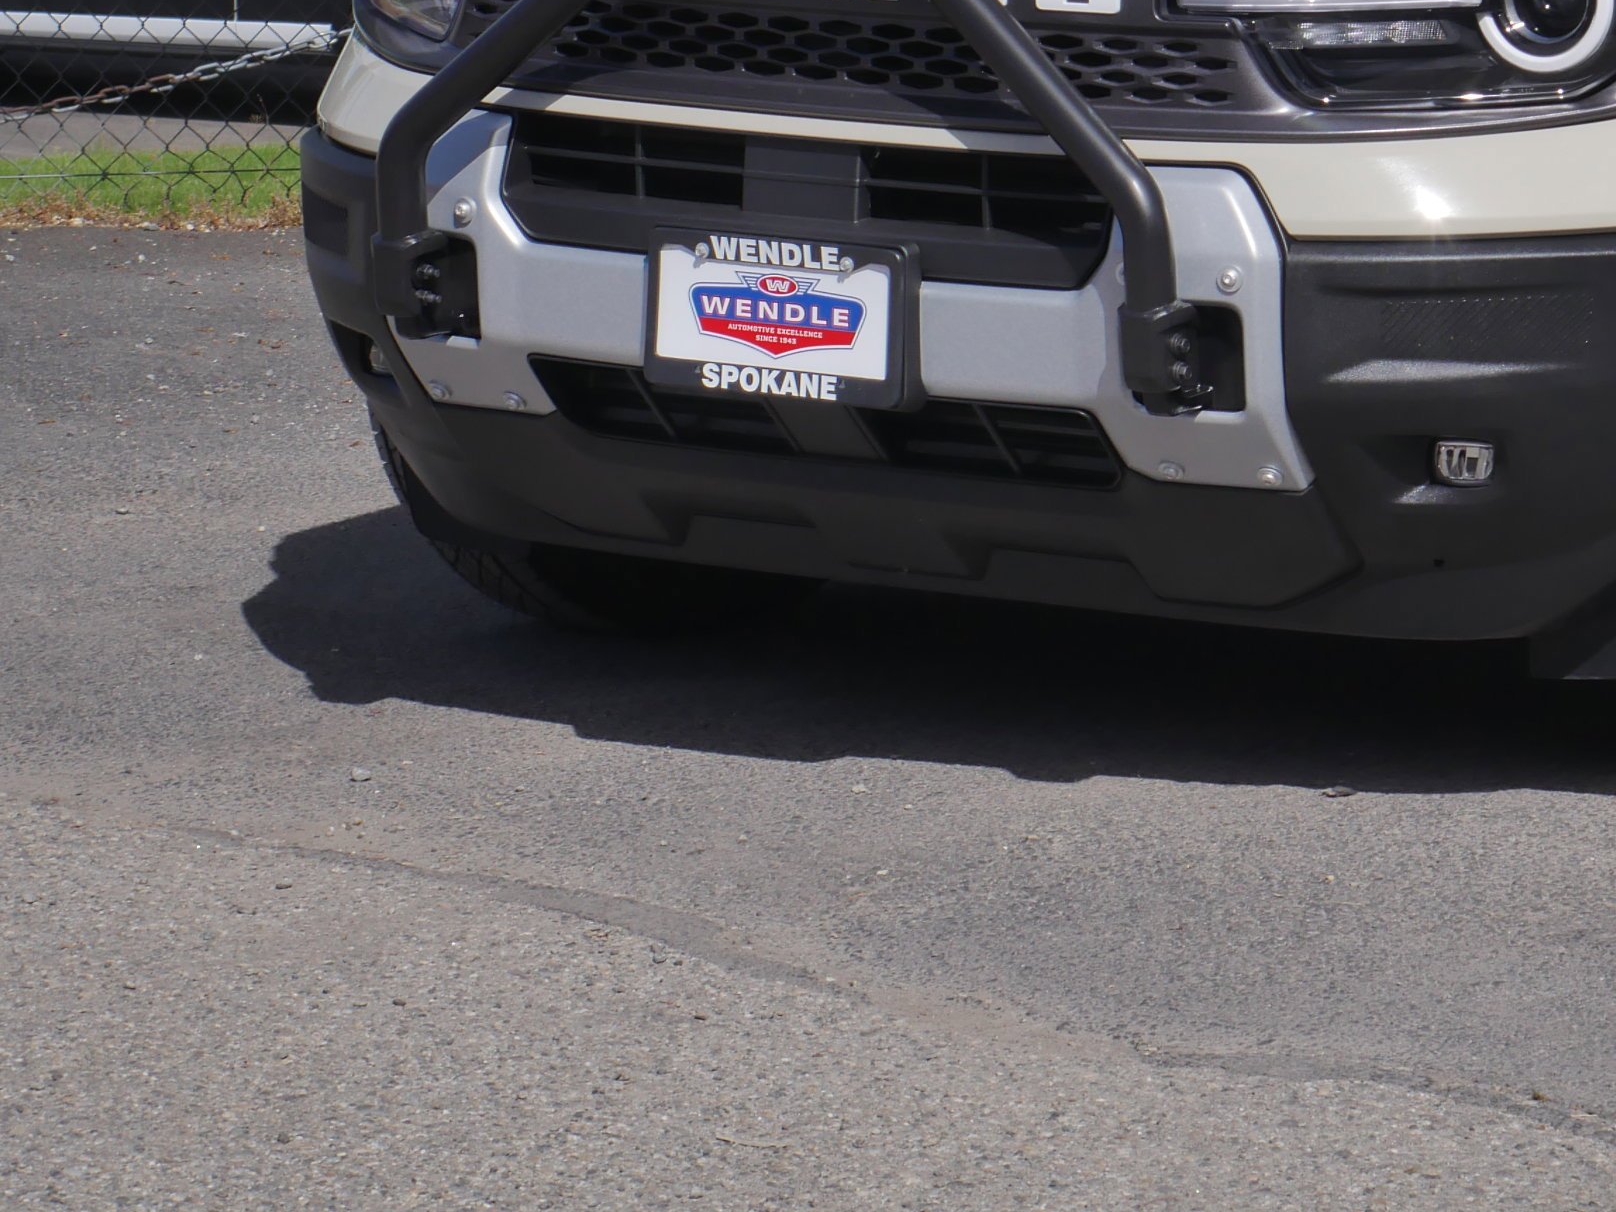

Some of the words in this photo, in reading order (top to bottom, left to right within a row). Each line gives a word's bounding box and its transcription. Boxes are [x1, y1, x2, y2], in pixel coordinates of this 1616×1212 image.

[710, 235, 841, 271] WENDLE
[702, 295, 850, 328] WENDLE
[728, 323, 775, 334] AUTOMOTIVE
[777, 328, 823, 338] EXCELLENCE
[755, 334, 777, 343] SINCE
[779, 336, 797, 345] 1943
[702, 363, 838, 401] SPOKANE
